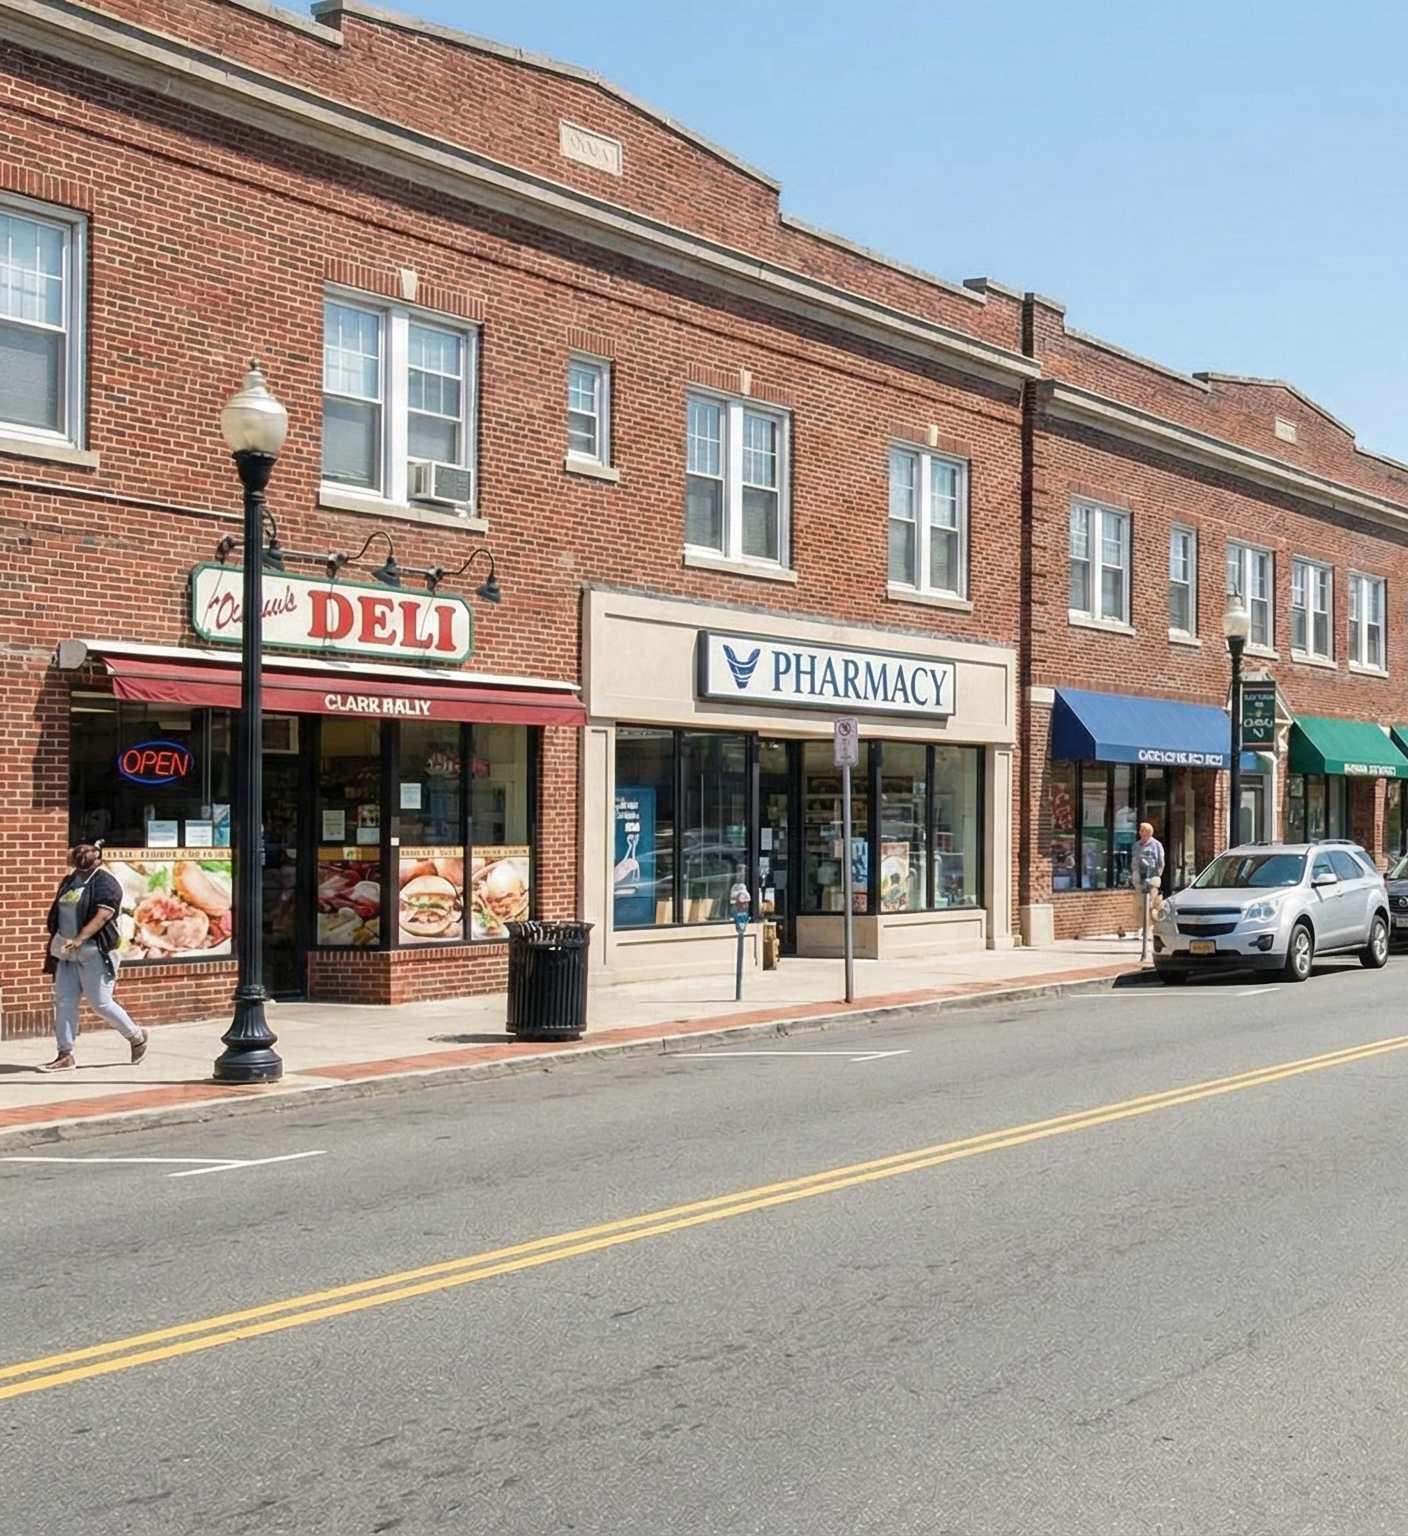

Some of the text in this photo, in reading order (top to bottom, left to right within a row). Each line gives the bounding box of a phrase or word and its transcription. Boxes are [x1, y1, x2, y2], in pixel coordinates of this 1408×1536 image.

[307, 590, 458, 653] DELI
[771, 651, 947, 705] PHARMACY
[123, 749, 188, 776] OPEN
